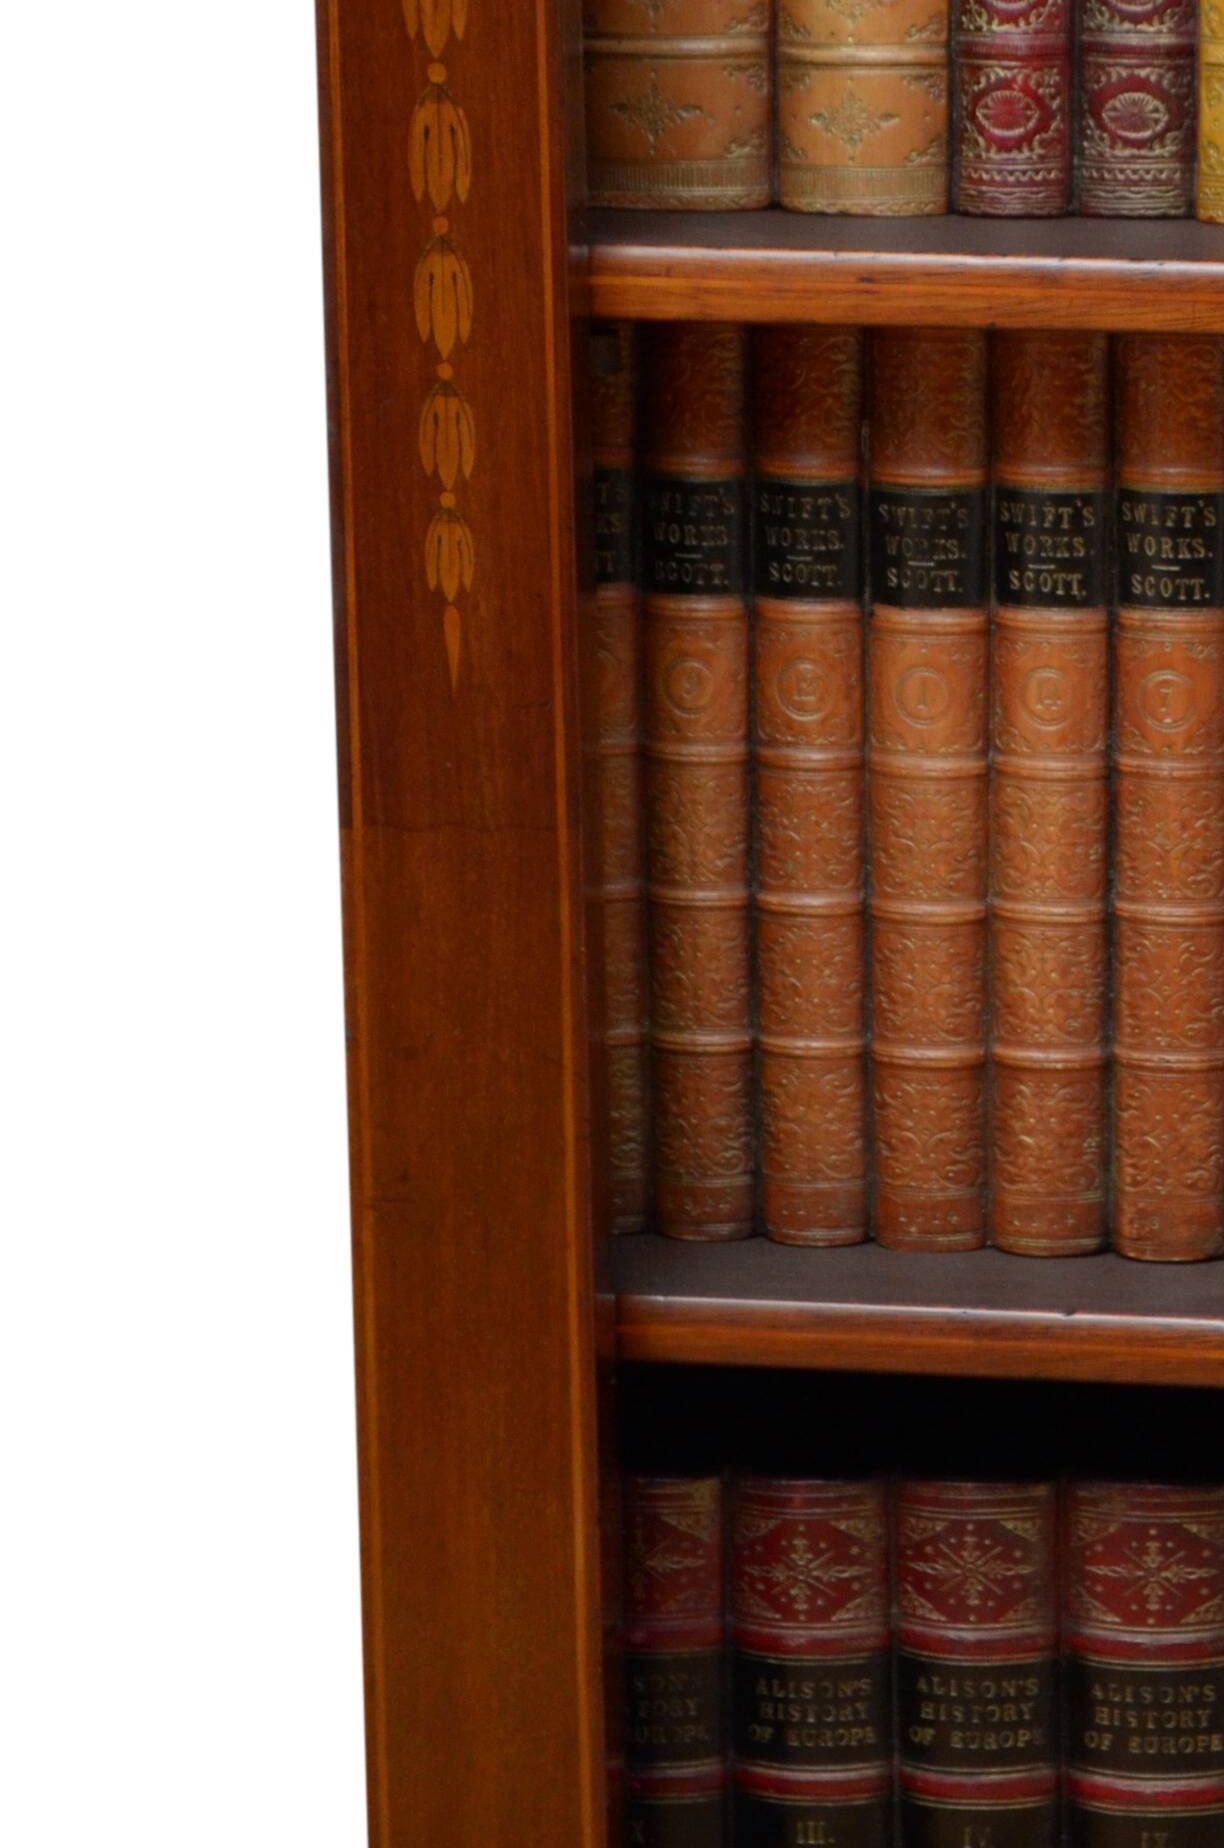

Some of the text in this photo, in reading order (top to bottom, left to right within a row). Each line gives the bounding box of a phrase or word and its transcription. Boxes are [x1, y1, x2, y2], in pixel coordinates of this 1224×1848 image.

[652, 487, 737, 519] WIFT'S
[759, 492, 851, 520] SWIFT'S
[999, 497, 1097, 529] SWIFT'S
[1120, 498, 1218, 529] SWIFT'S
[877, 500, 969, 532] SWIFT'S
[1126, 531, 1214, 559] WORKS.
[885, 566, 965, 593] SCOTT.
[1008, 568, 1087, 598] SCOTT.
[1130, 572, 1212, 601] SCOTT.
[755, 1678, 873, 1700] ALISON'S
[916, 1675, 1040, 1699] ALISON'S
[1091, 1681, 1217, 1704] ALISON'S
[760, 1701, 869, 1723] HISTORY
[919, 1701, 1036, 1723] HISTORY
[1094, 1705, 1213, 1729] HISTORY
[785, 1724, 879, 1748] EUROPE
[908, 1726, 1047, 1750] OF EUROPE
[1083, 1729, 1114, 1752] OF
